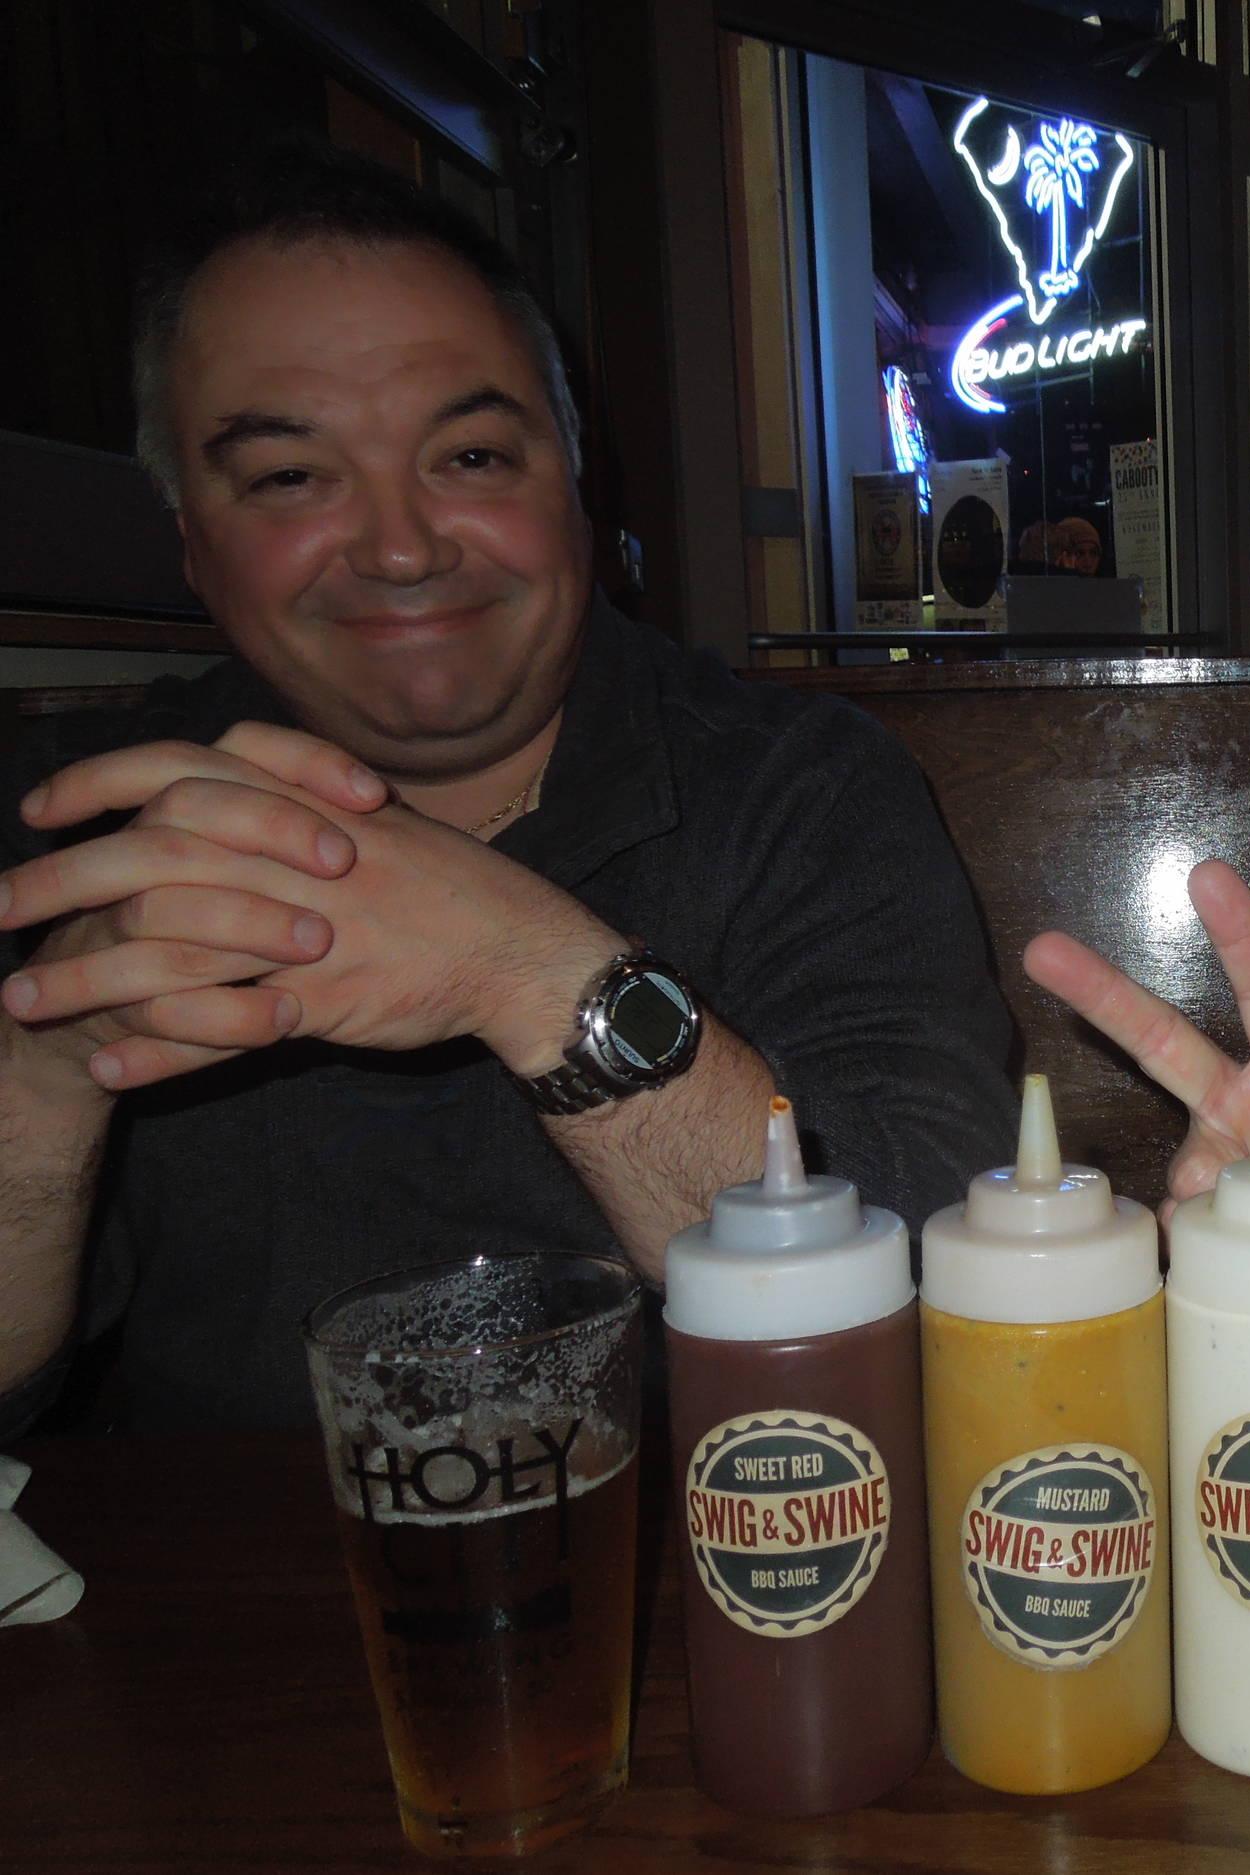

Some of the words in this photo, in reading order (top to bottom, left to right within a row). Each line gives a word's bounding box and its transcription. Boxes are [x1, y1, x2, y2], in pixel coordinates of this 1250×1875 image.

[965, 342, 1035, 384] BUD
[1037, 319, 1146, 369] LIGHT
[346, 1416, 585, 1545] HOLY
[734, 1456, 787, 1482] SWEET
[791, 1452, 824, 1480] RED
[689, 1488, 758, 1548] SWIG
[762, 1508, 780, 1541] &
[783, 1476, 887, 1547] SWINE
[1036, 1486, 1111, 1512] MUSTARD
[965, 1509, 1046, 1574] SWIG
[1046, 1538, 1064, 1570] &
[1066, 1519, 1155, 1578] SWINE
[751, 1569, 777, 1589] BBQ
[778, 1566, 820, 1588] SAUCE
[1025, 1594, 1050, 1617] BBQ
[1052, 1598, 1092, 1618] SAUCE
